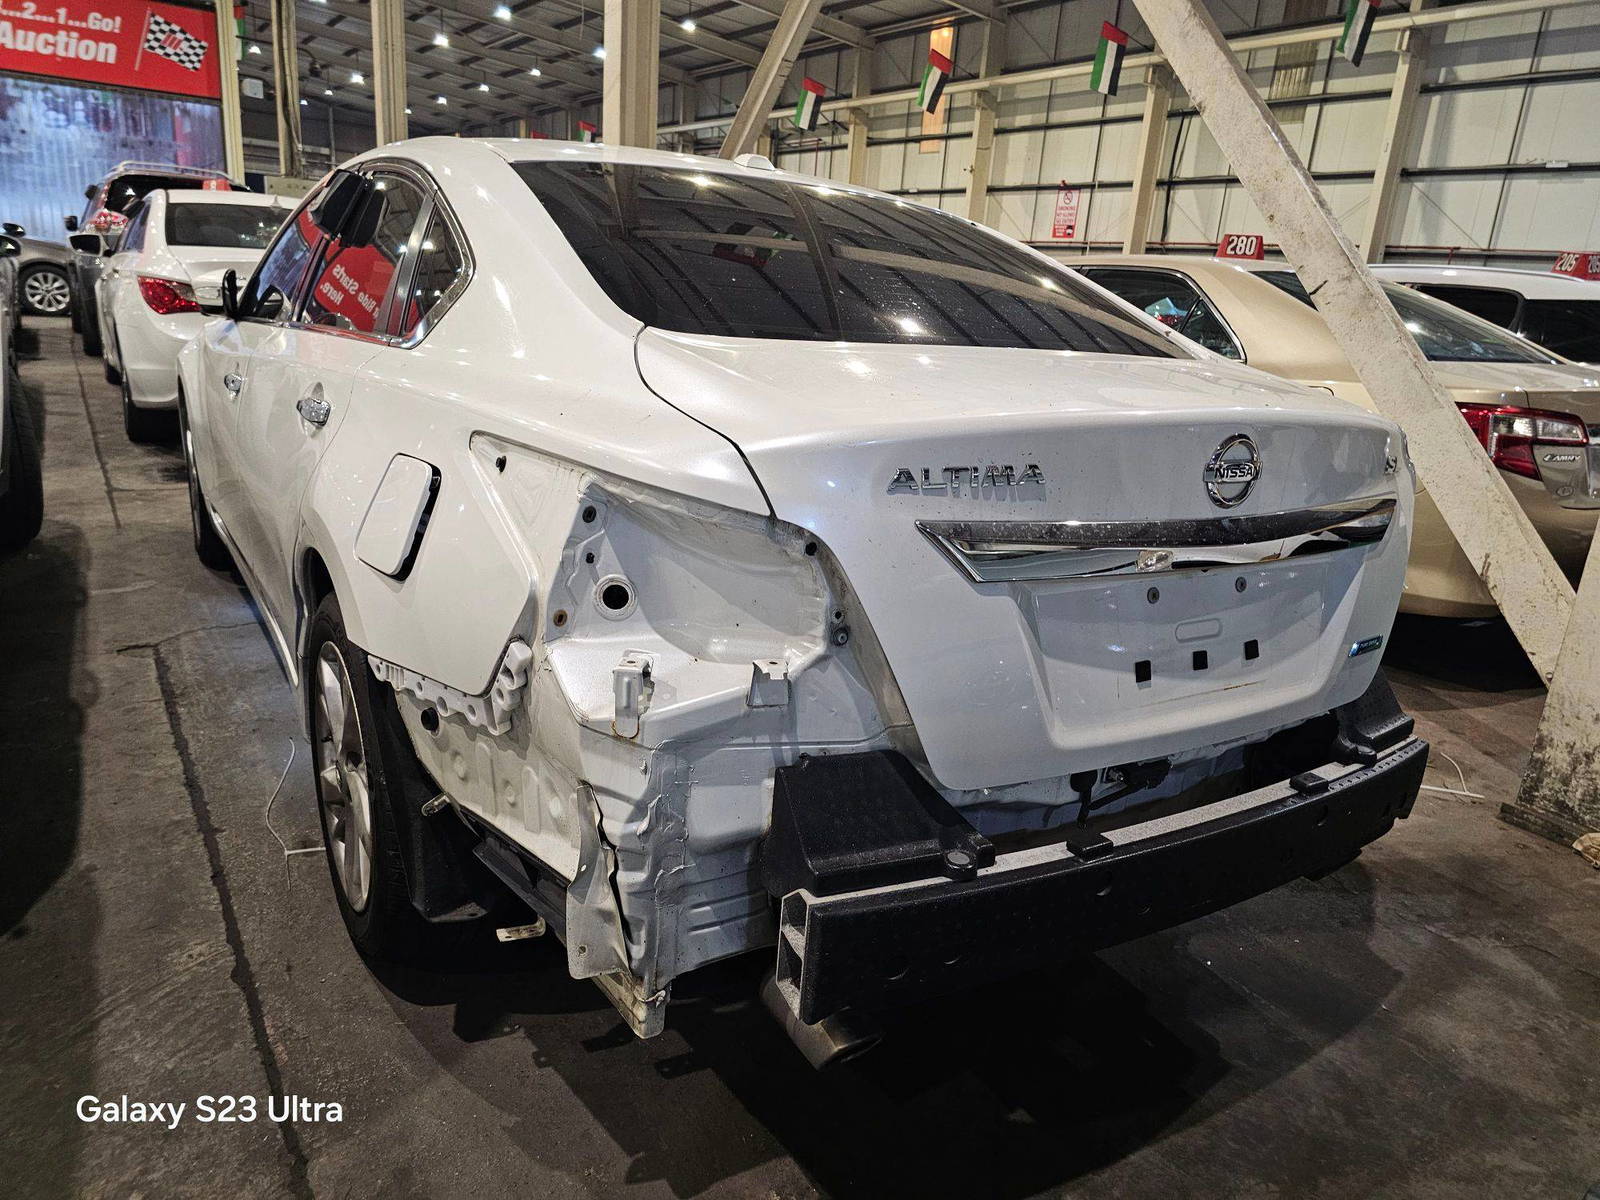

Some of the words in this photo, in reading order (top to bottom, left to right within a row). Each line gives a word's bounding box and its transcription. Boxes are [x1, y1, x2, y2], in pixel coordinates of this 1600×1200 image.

[0, 0, 122, 33] ...2...1...Go!
[0, 20, 117, 64] Auction
[1226, 236, 1257, 256] 280
[1555, 253, 1580, 271] 205
[1543, 454, 1581, 462] CAMRY
[887, 464, 1046, 492] ALTIMA
[1214, 465, 1257, 479] NISSA
